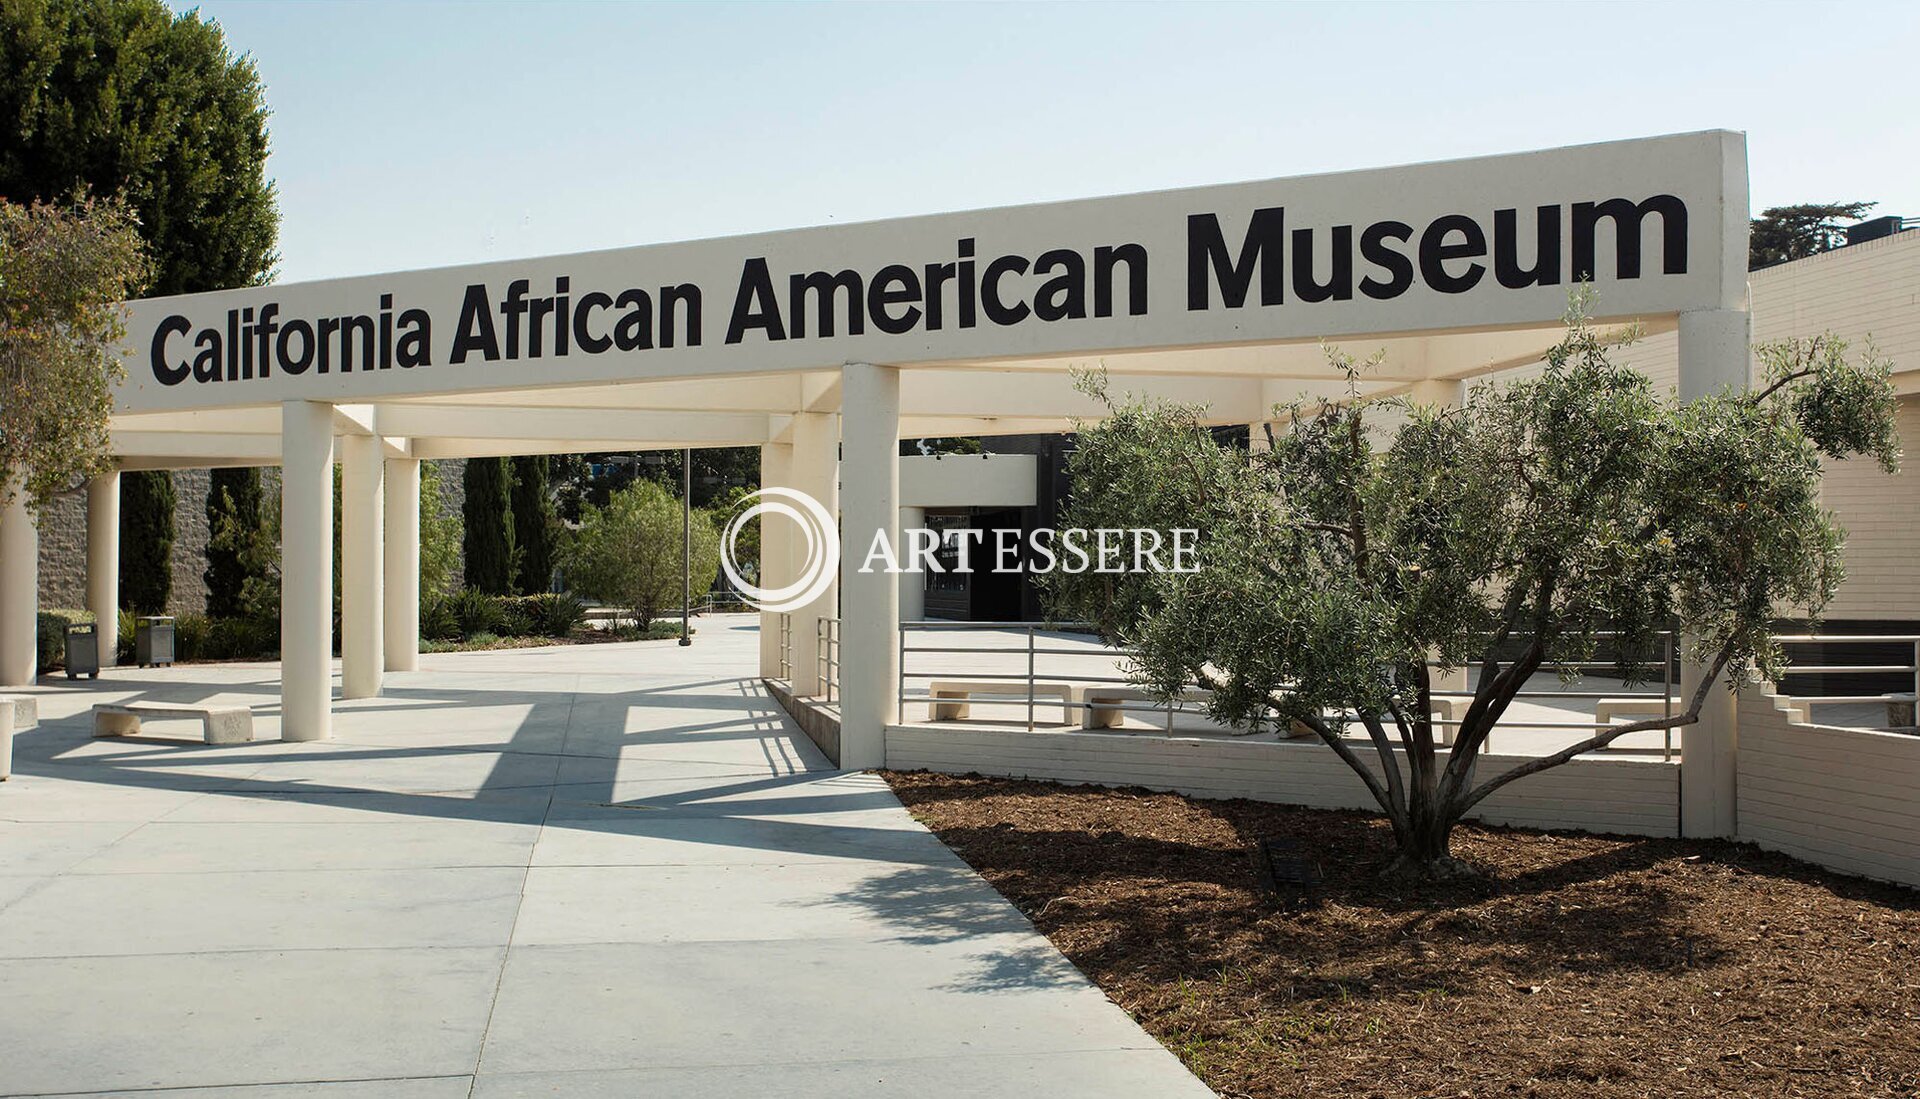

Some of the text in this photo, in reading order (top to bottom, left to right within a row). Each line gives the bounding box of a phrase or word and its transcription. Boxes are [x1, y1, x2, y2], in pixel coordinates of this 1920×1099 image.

[151, 194, 1689, 387] California African American Museum
